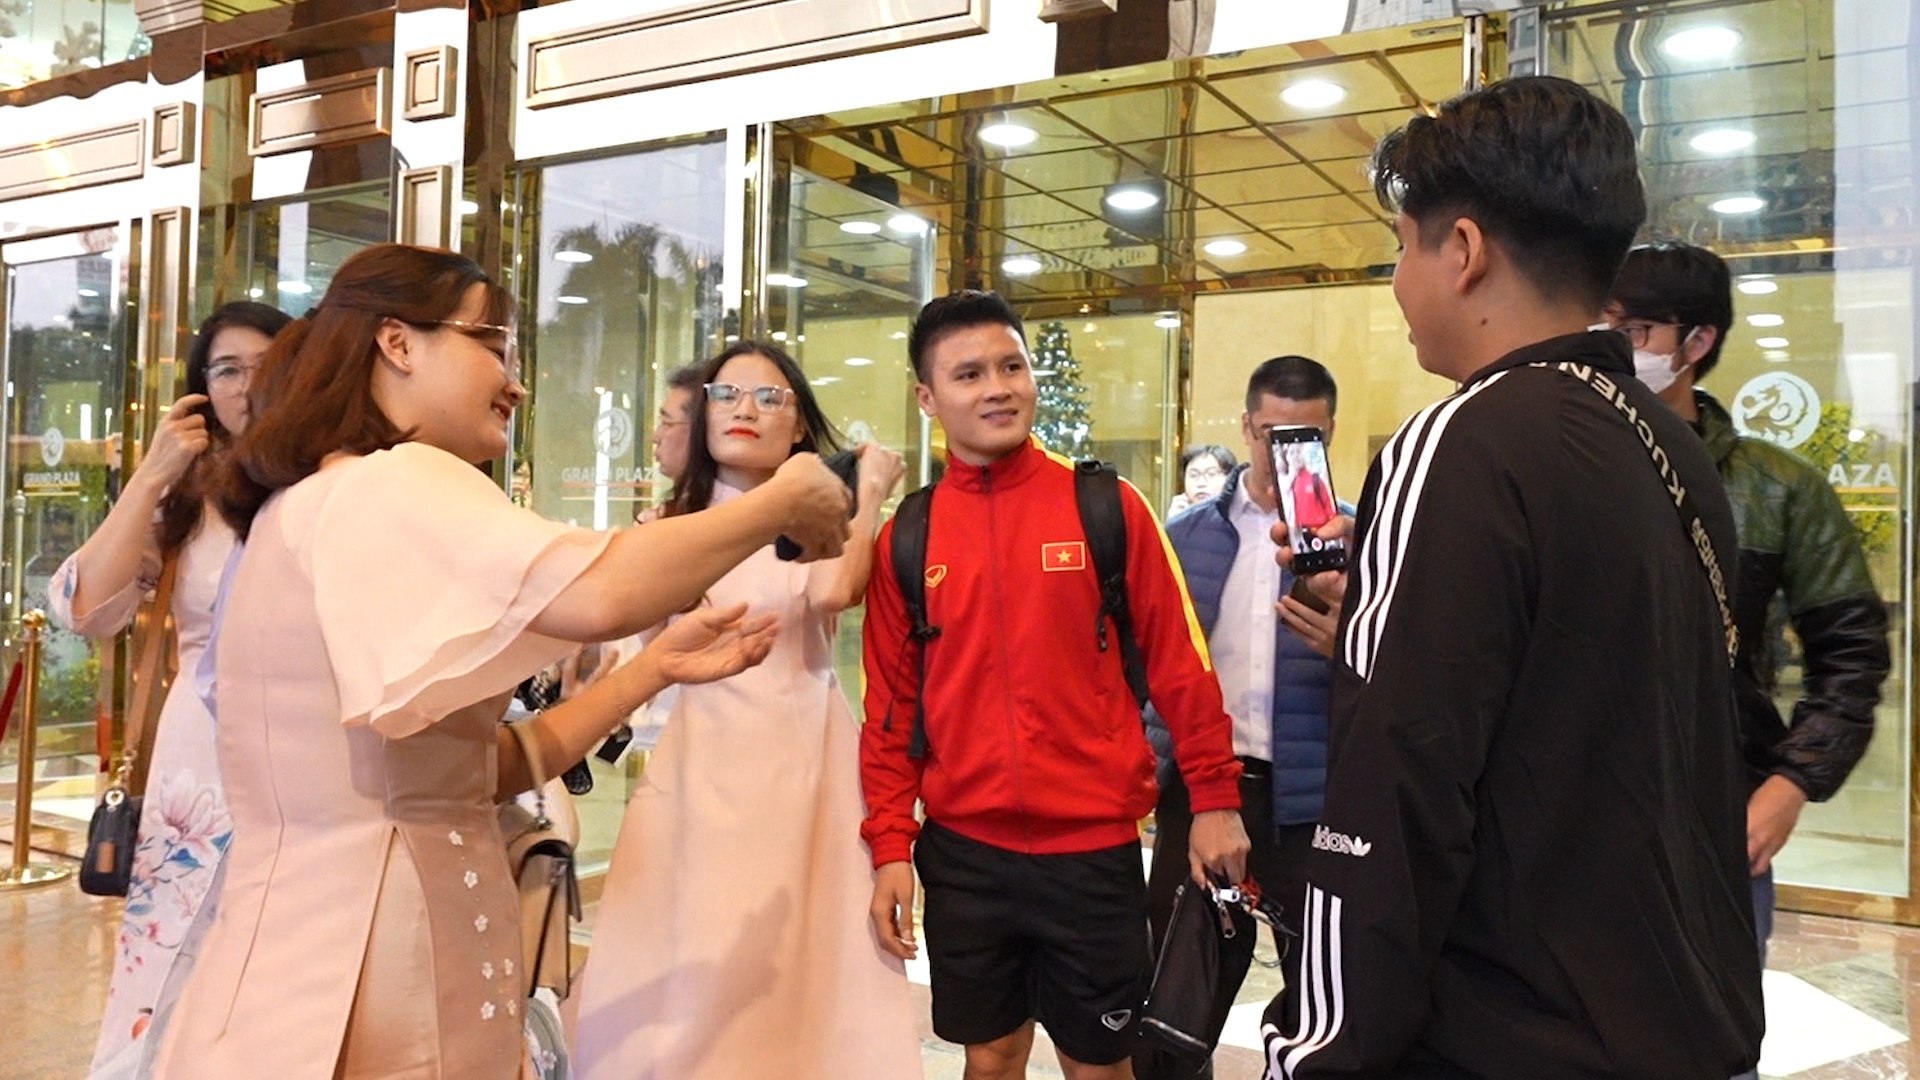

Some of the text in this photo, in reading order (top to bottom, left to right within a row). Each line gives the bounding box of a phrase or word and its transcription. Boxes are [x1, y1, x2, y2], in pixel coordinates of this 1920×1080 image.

[1529, 361, 1686, 507] KUCHEN
[53, 472, 80, 484] PLAZA
[561, 467, 657, 482] GRA PLAZ
[1827, 463, 1897, 487] AZA
